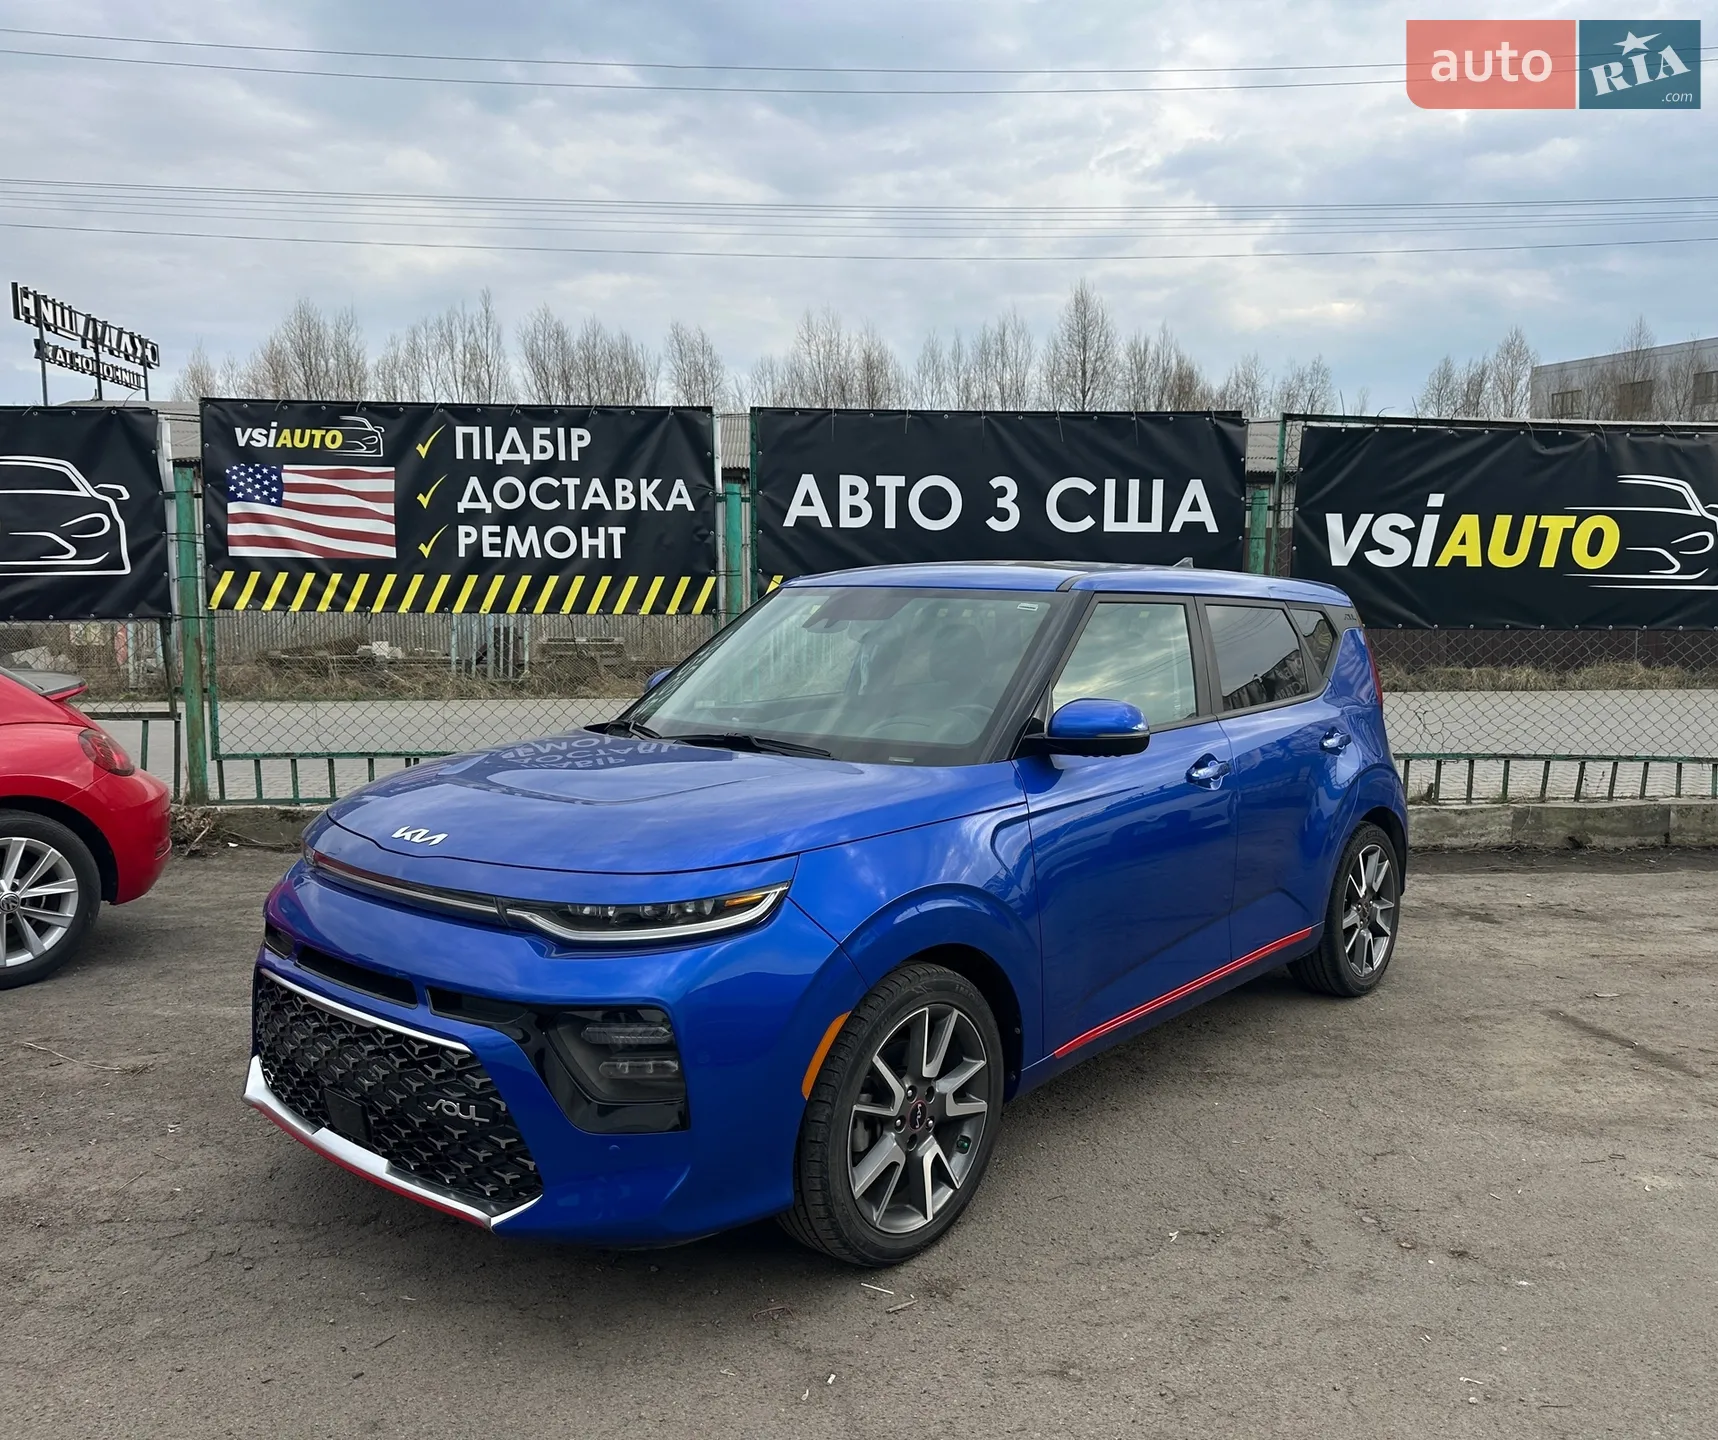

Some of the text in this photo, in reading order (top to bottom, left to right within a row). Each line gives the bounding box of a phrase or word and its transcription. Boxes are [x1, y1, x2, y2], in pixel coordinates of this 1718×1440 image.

[454, 424, 592, 466] ПІДБІР
[456, 475, 697, 515] ДОСТАВКА
[782, 473, 964, 532] АВТО
[1044, 476, 1220, 534] США
[457, 525, 627, 560] РЕМОНТ
[391, 825, 449, 847] KIA
[422, 1098, 491, 1127] SOUL
